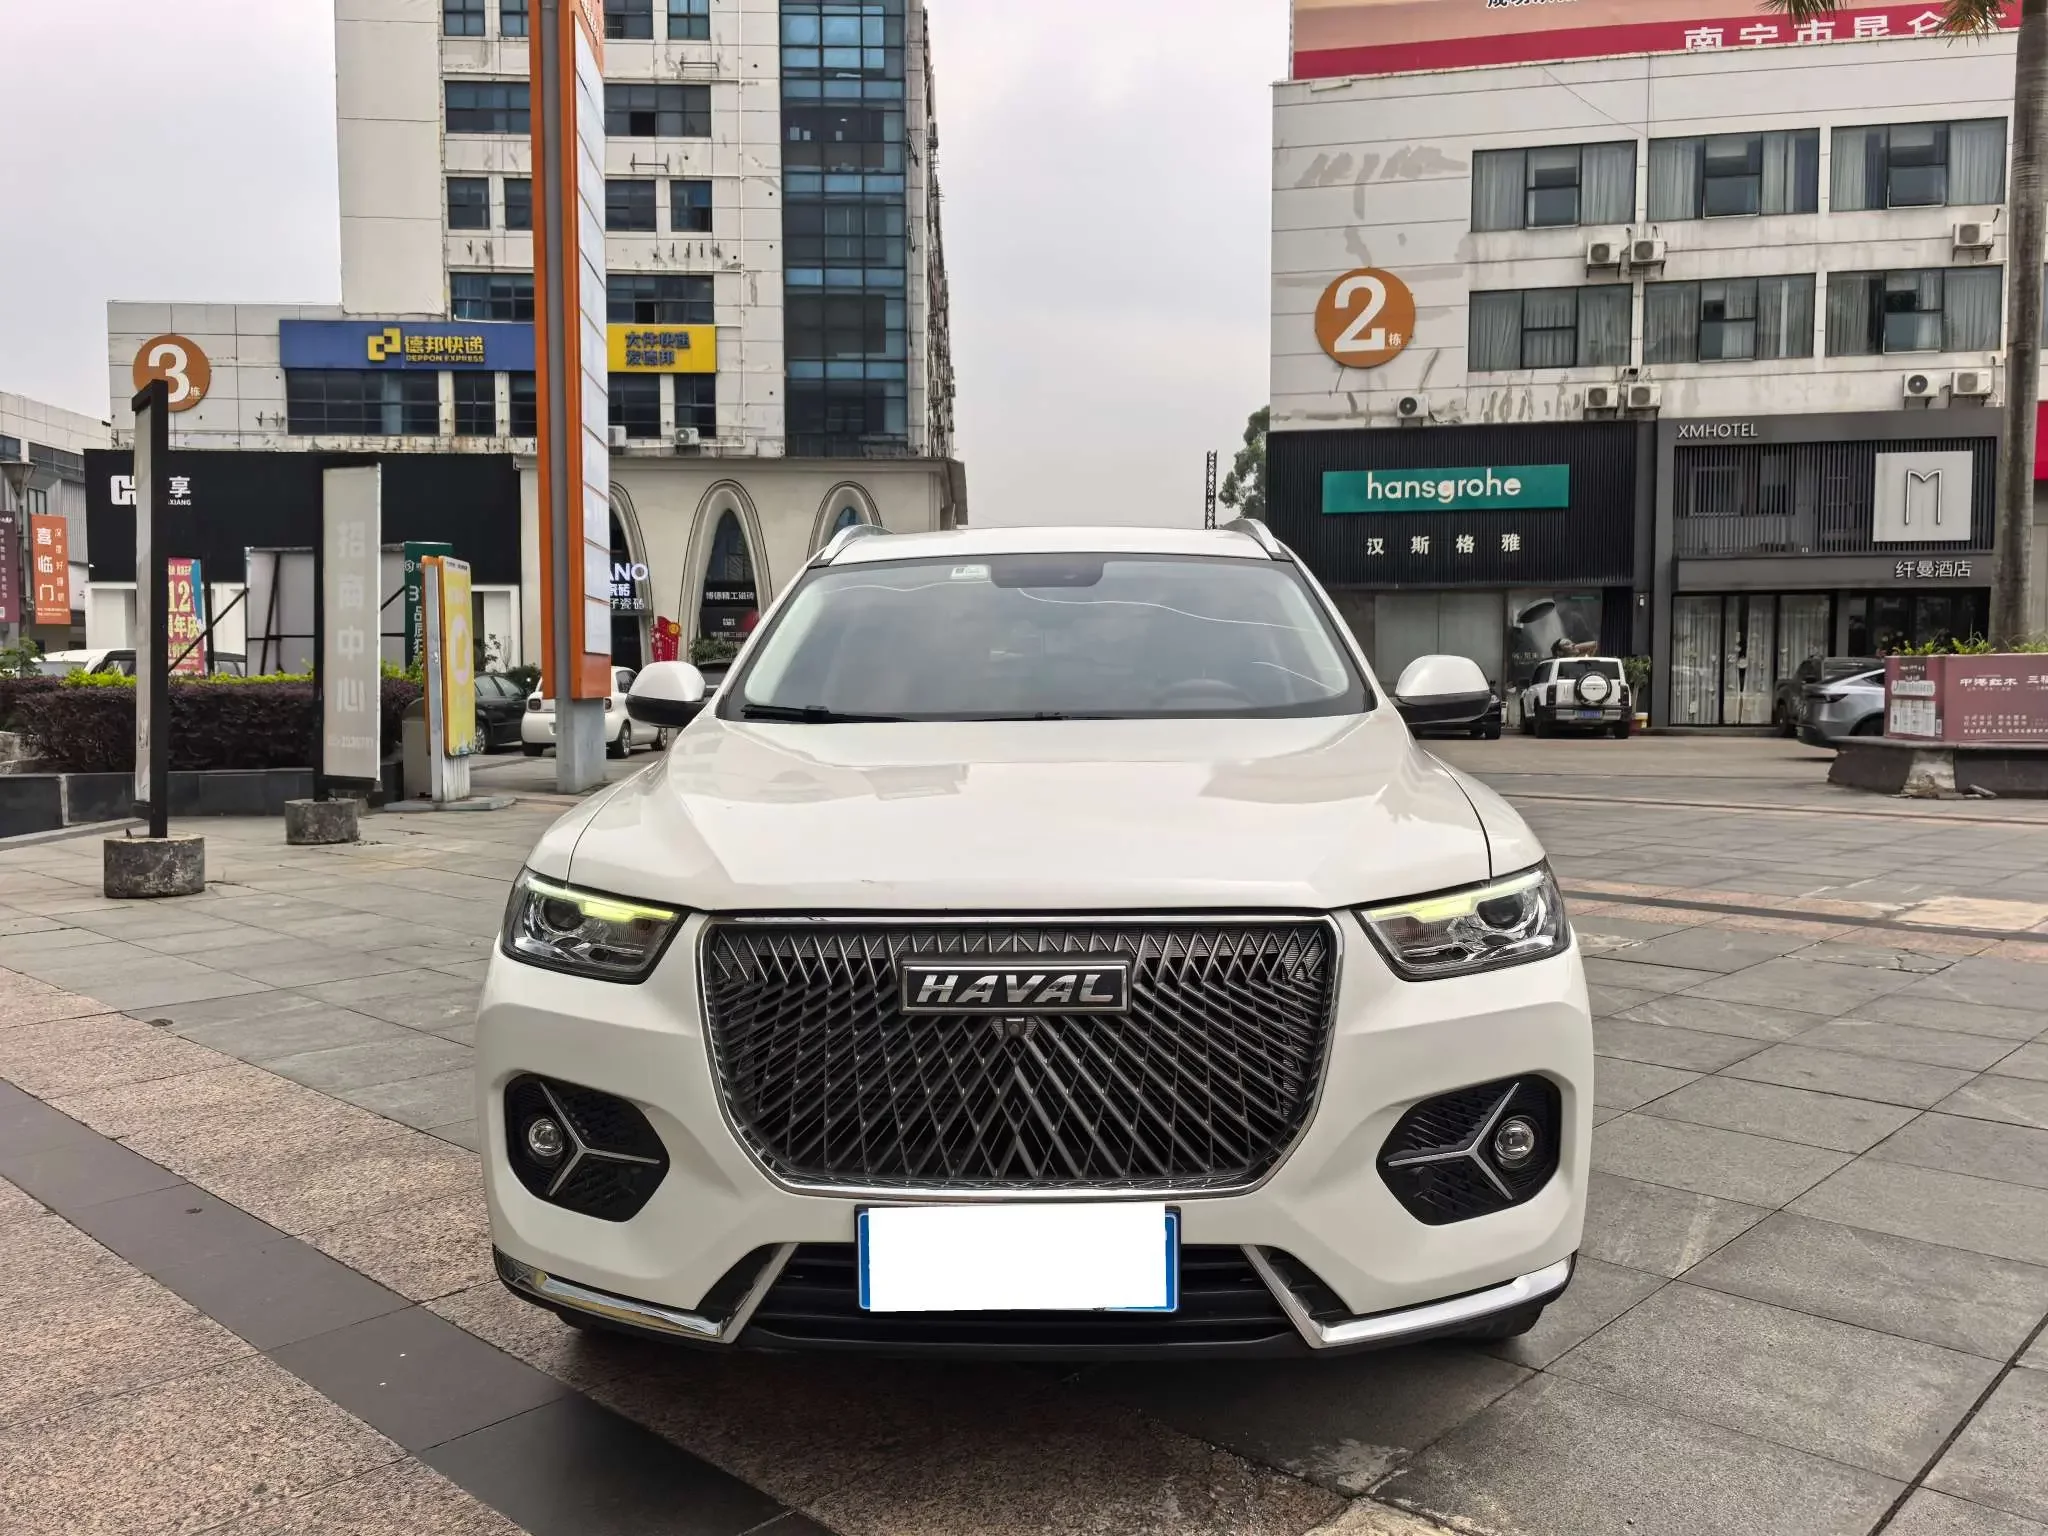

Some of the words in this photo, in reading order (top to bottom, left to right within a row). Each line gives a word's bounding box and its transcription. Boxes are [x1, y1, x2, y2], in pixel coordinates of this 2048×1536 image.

[1684, 11, 2006, 49] 南宁市昆仑
[404, 335, 484, 354] 德邦快递
[405, 354, 442, 362] DEPPON
[444, 354, 485, 363] EXPRESS
[1677, 423, 1759, 439] XMHOTEL
[1367, 467, 1522, 503] hansgrohe
[1366, 533, 1522, 556] 汉斯格雅
[36, 527, 55, 602] 喜临门
[1894, 560, 1973, 578] 纤曼酒店
[336, 520, 366, 716] 招商中心
[916, 974, 1114, 1003] HAVAL
